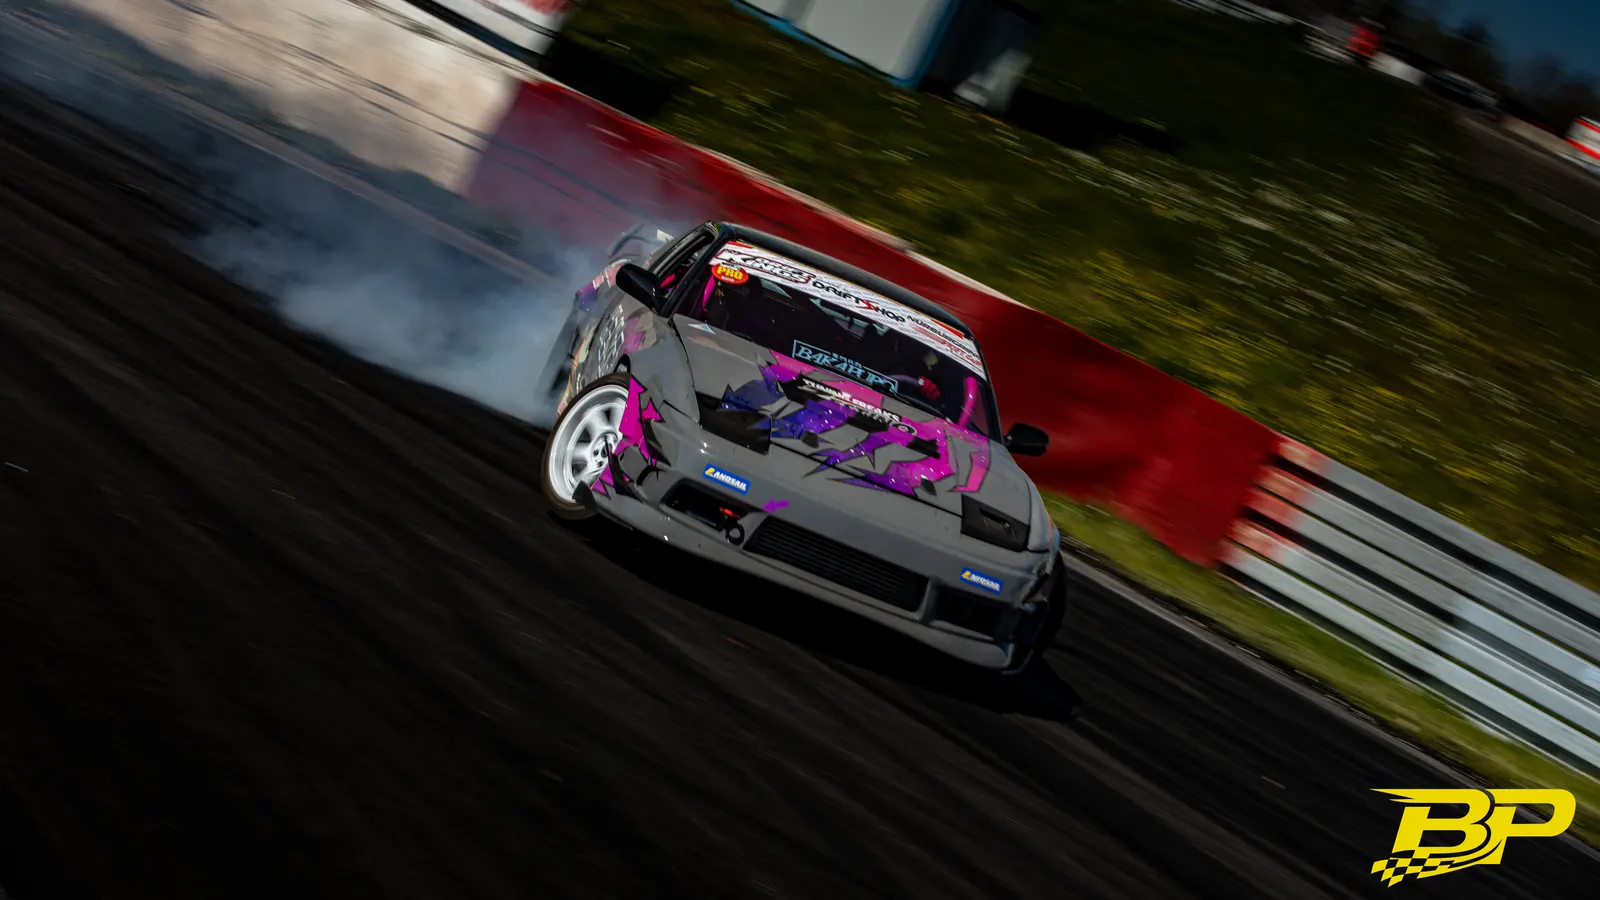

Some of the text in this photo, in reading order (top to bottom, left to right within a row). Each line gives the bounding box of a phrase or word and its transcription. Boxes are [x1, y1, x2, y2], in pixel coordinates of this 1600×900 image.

[716, 250, 809, 284] KINGS
[716, 266, 743, 280] PRO
[704, 467, 747, 492] LANDSAIL
